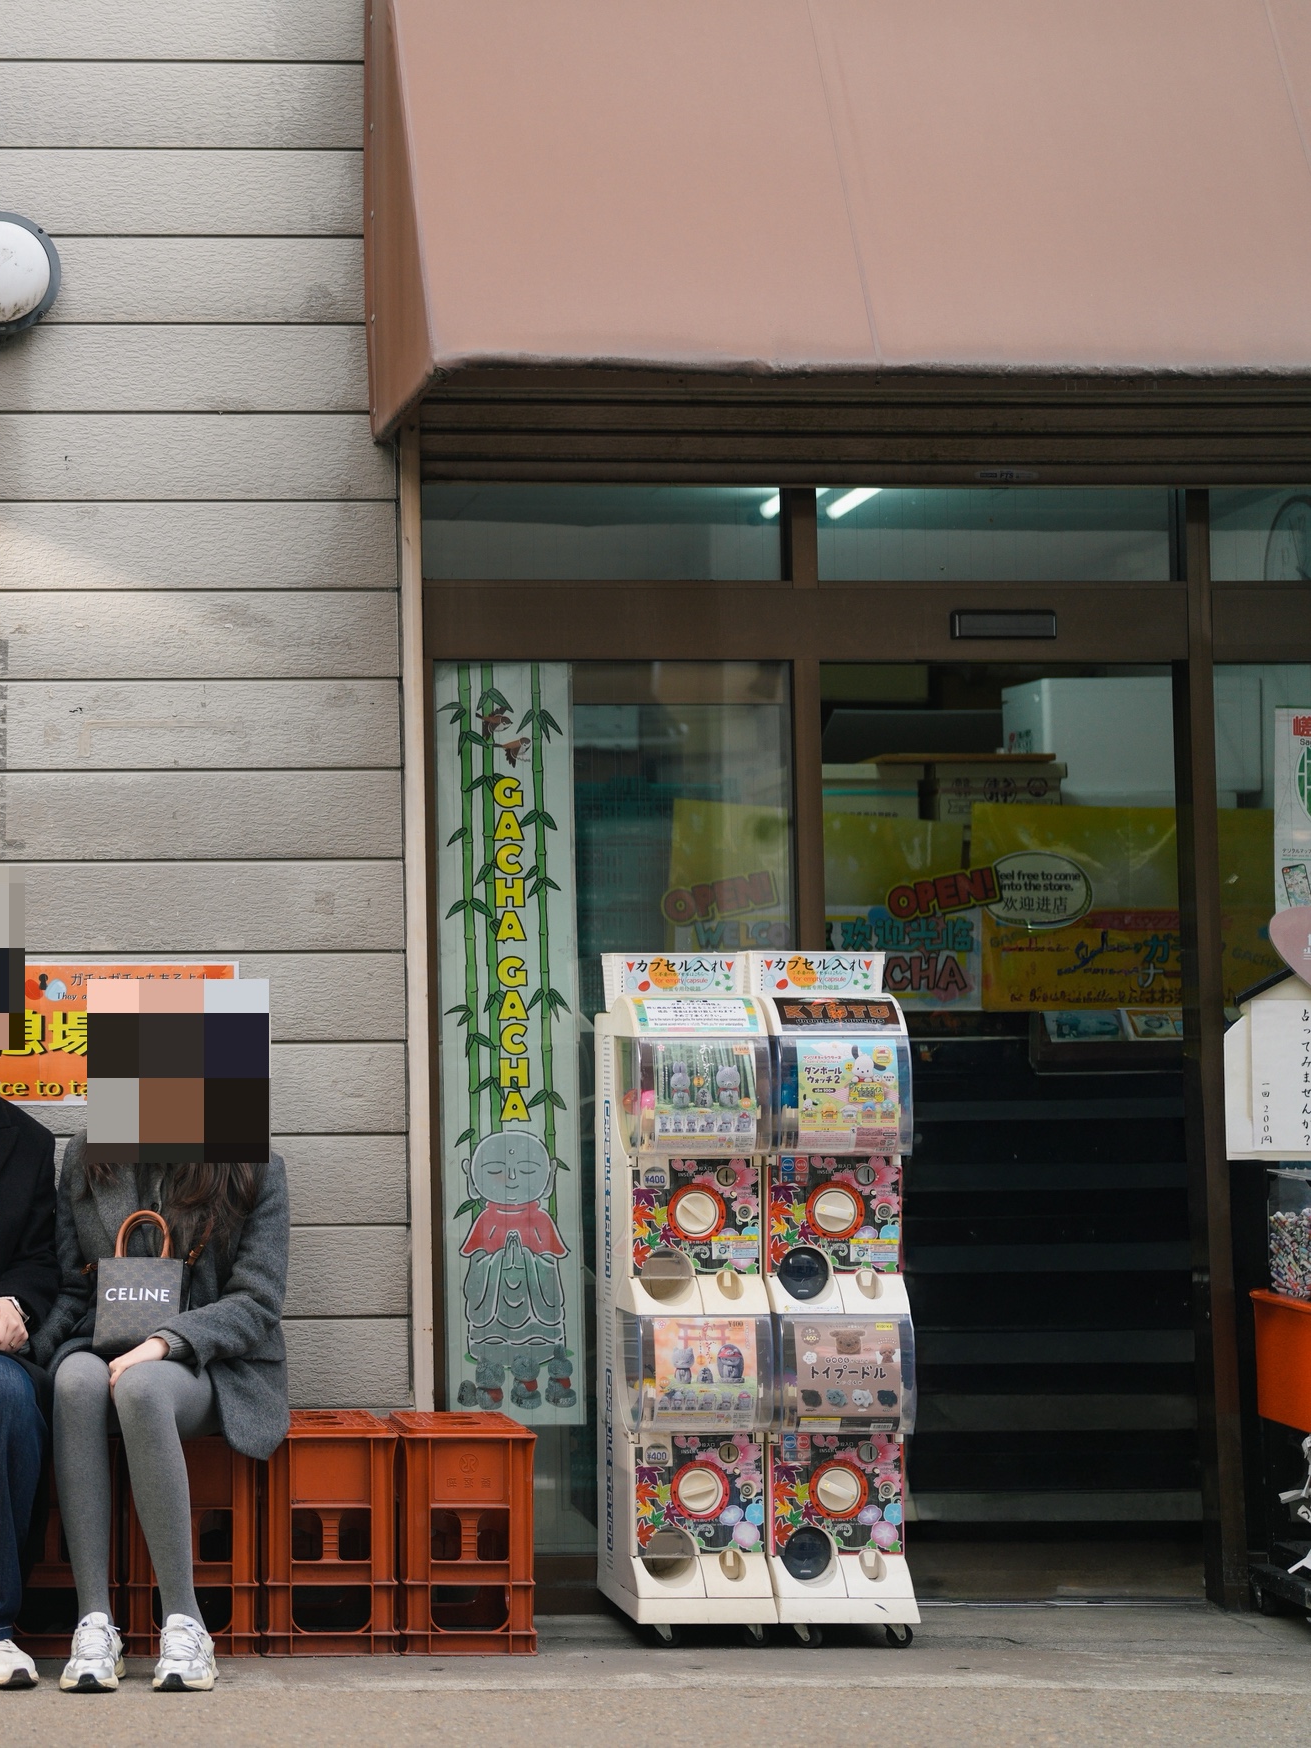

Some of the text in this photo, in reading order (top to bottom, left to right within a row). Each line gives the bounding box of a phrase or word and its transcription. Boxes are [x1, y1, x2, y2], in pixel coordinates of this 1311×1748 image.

[1017, 870, 1039, 881] free
[1041, 871, 1053, 881] to
[1053, 872, 1081, 881] come
[888, 865, 1000, 918] OPEN!
[1001, 881, 1074, 891] into the store.
[664, 871, 776, 921] OPEN!
[1002, 895, 1069, 914] 欢迎进店
[841, 917, 974, 952] 欢迎光临
[493, 777, 531, 1123] GACHA GACHA
[686, 977, 709, 985] capsule
[824, 976, 847, 984] capsule
[56, 991, 78, 1002] They
[783, 1005, 890, 1019] KYOTO
[804, 1066, 843, 1075] ダンボール
[807, 1075, 841, 1084] ウォッチ2
[35, 1079, 60, 1096] to
[644, 1175, 666, 1184] ¥400
[105, 1287, 170, 1302] CELINE
[729, 1321, 744, 1332] ¥400
[810, 1364, 887, 1380] トイプードル
[646, 1451, 668, 1460] ¥400
